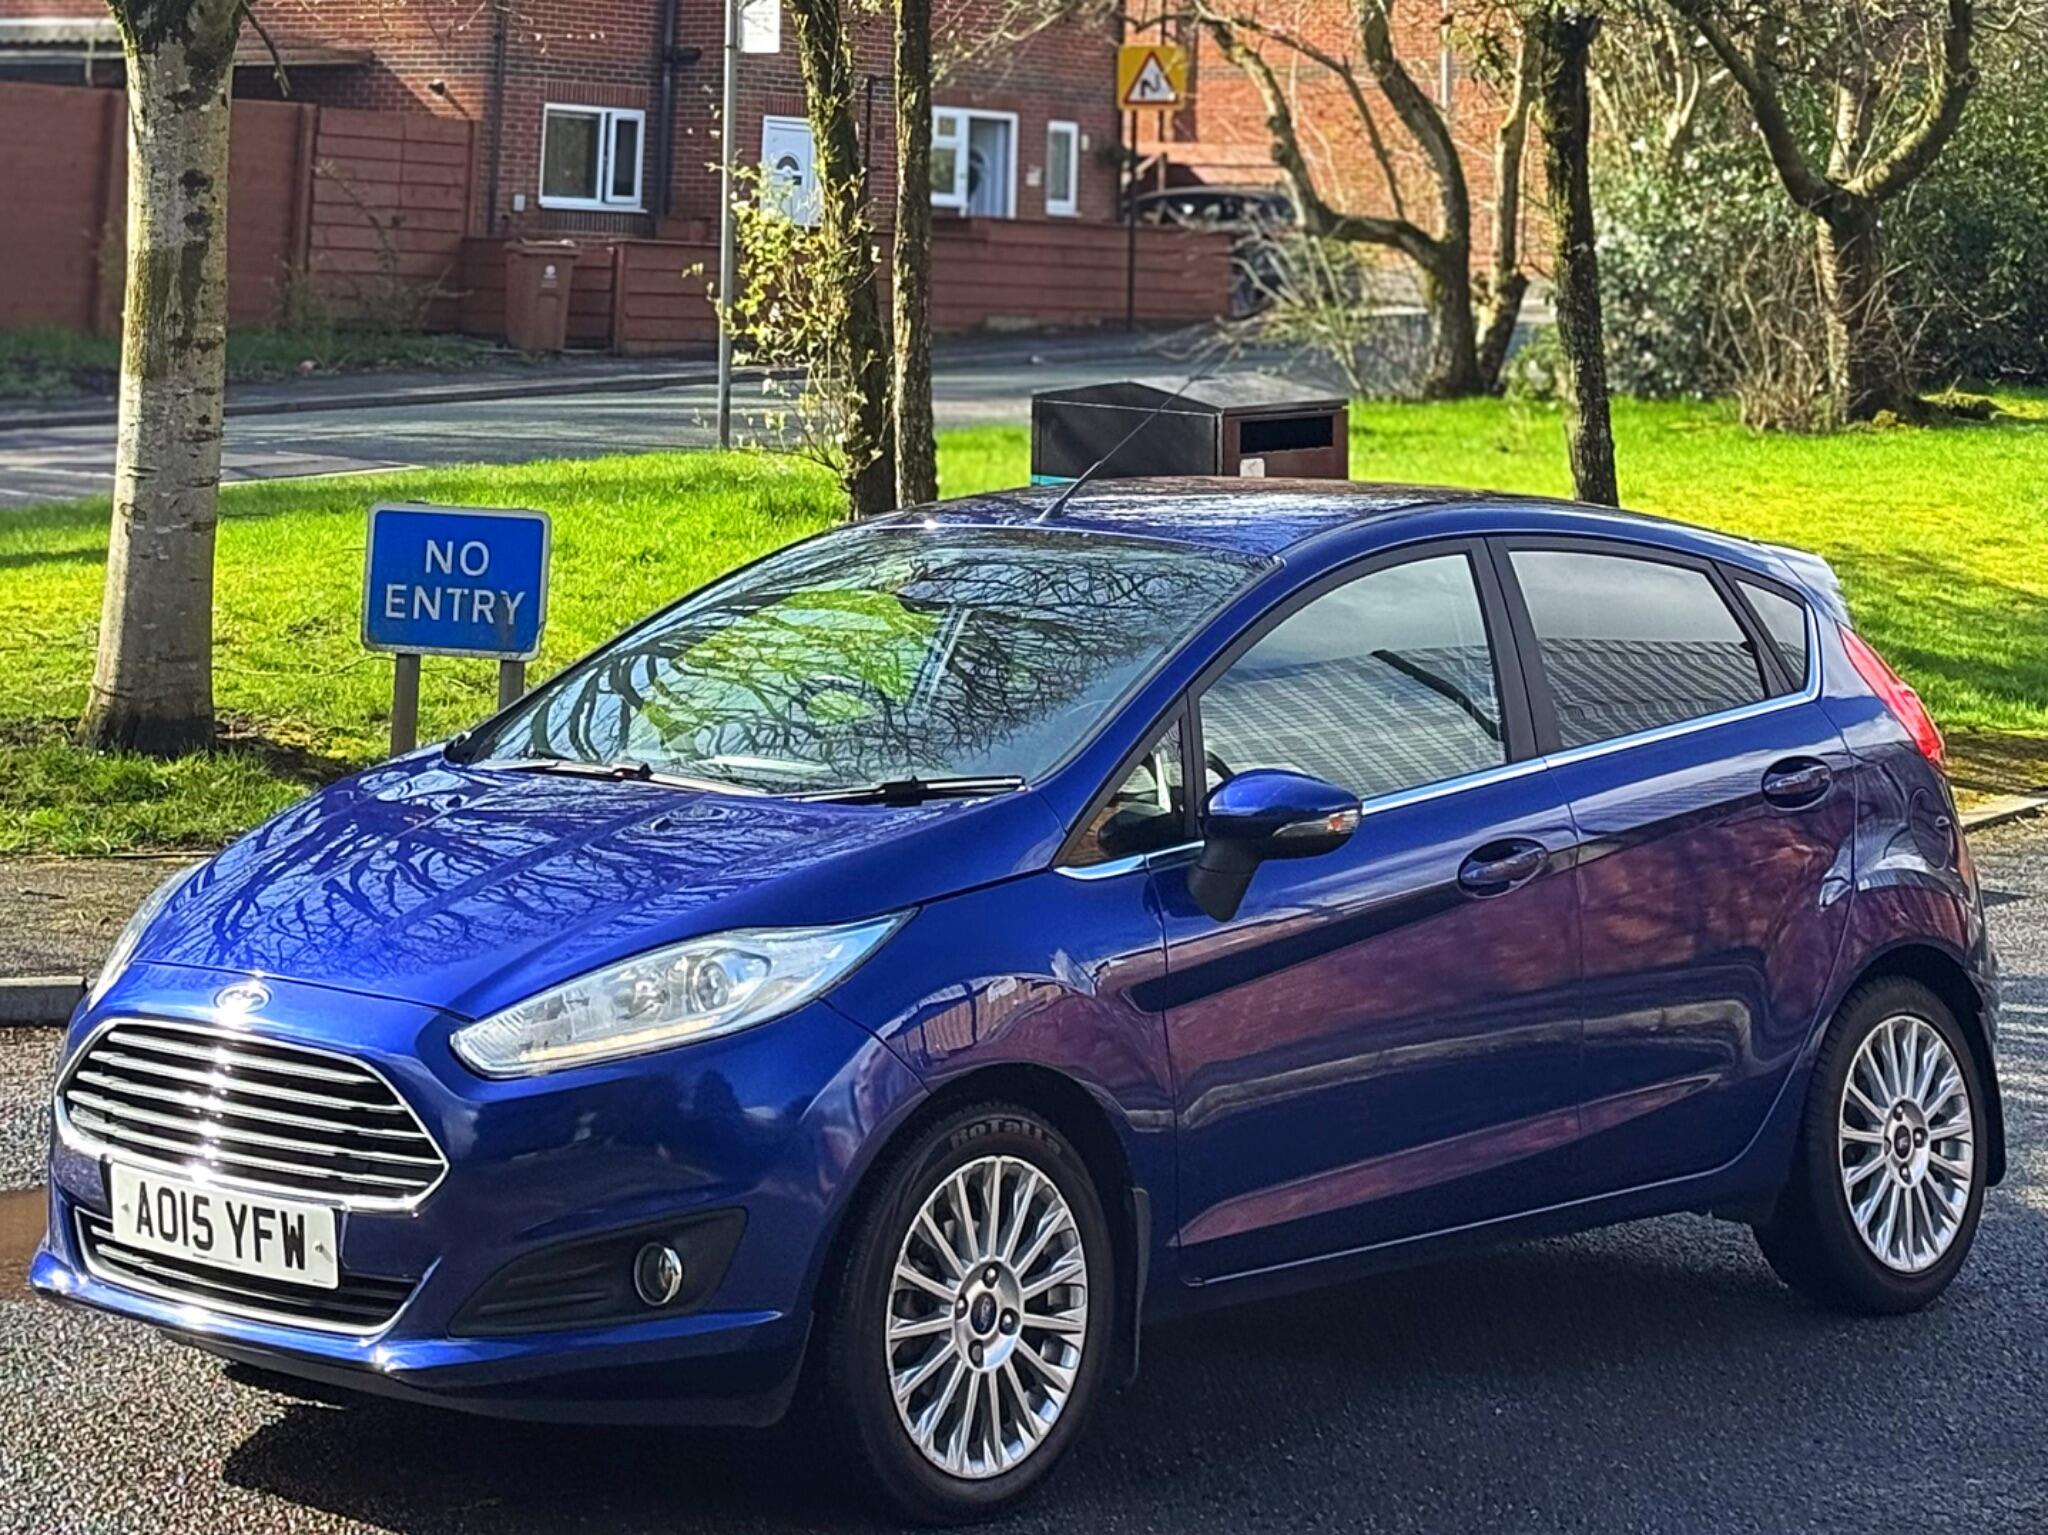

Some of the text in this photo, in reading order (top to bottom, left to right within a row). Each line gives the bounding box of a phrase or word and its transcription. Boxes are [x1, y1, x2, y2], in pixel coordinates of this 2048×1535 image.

[425, 540, 490, 576] NO
[385, 584, 526, 625] ENTRY
[136, 1181, 305, 1271] AO15 YFW
